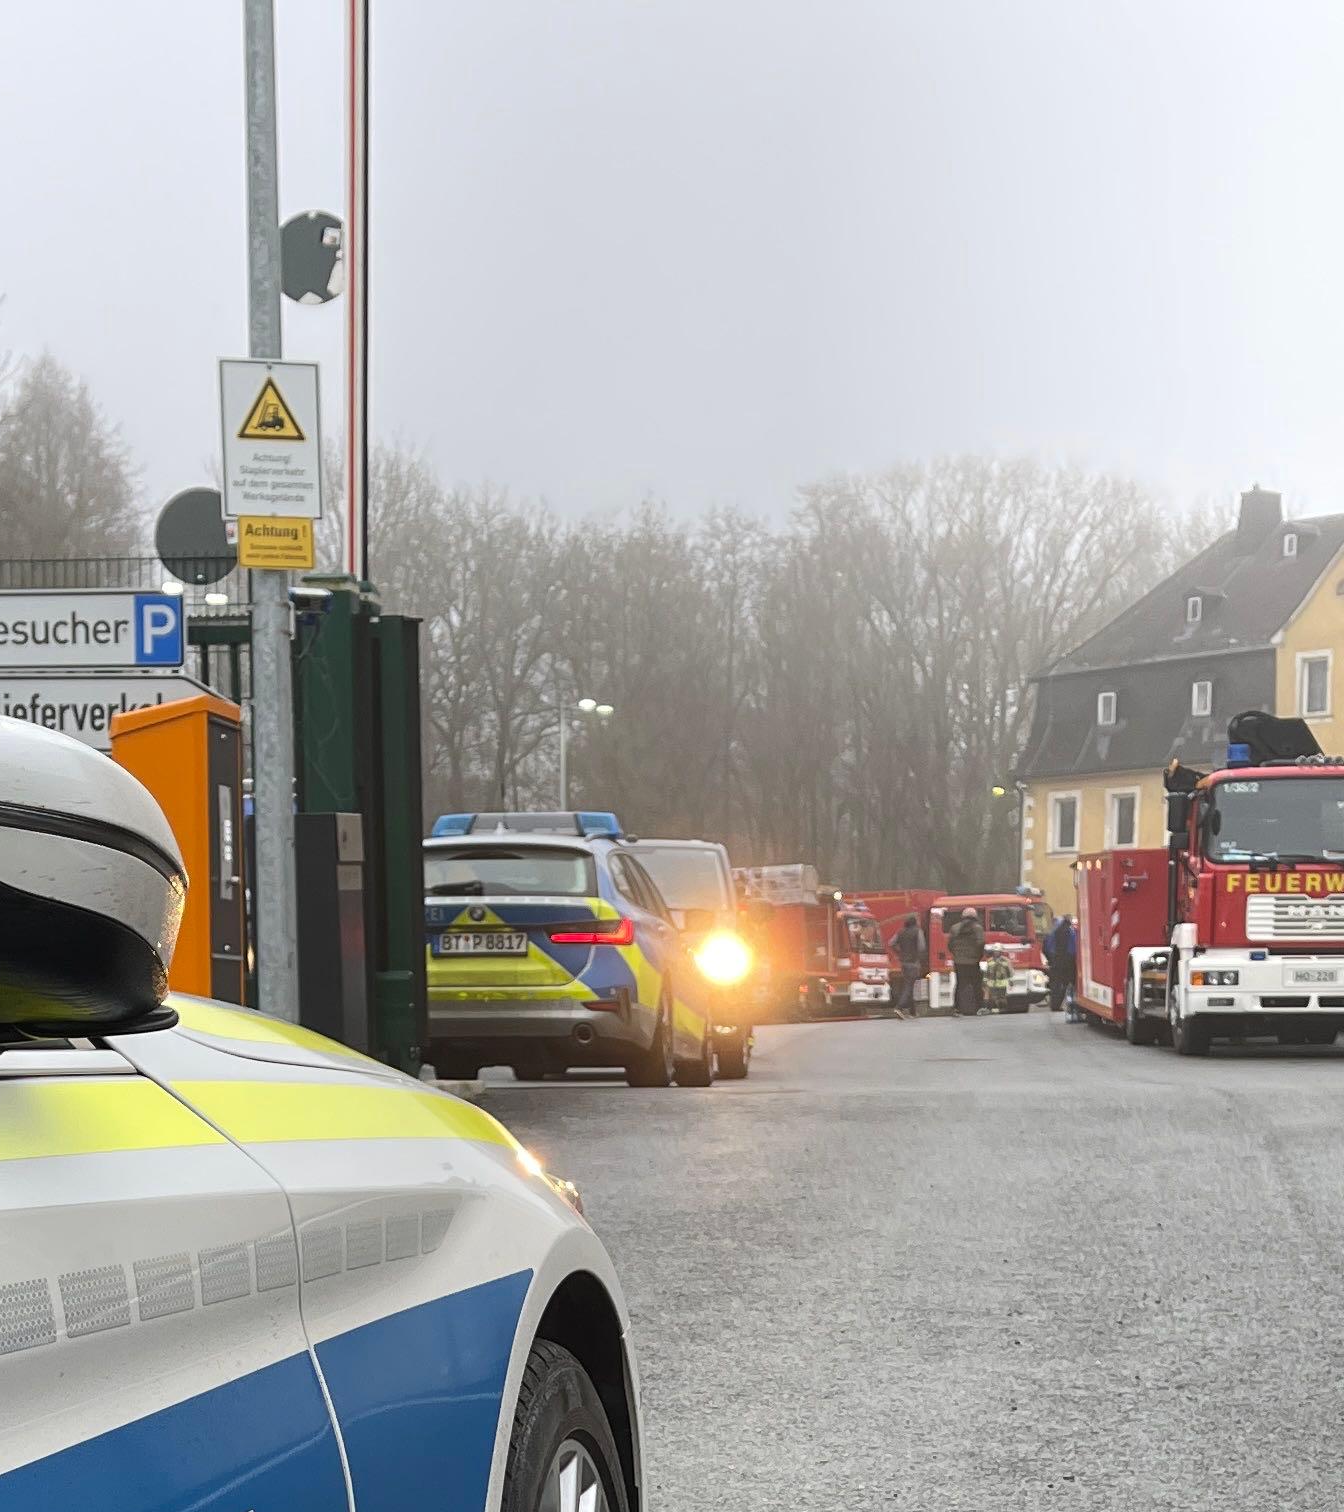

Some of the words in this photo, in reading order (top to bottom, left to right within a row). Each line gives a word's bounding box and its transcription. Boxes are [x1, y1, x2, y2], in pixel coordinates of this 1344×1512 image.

[245, 523, 299, 540] Achtung
[142, 604, 176, 654] P
[442, 935, 462, 950] BT
[472, 934, 483, 950] P
[486, 933, 525, 951] 8817
